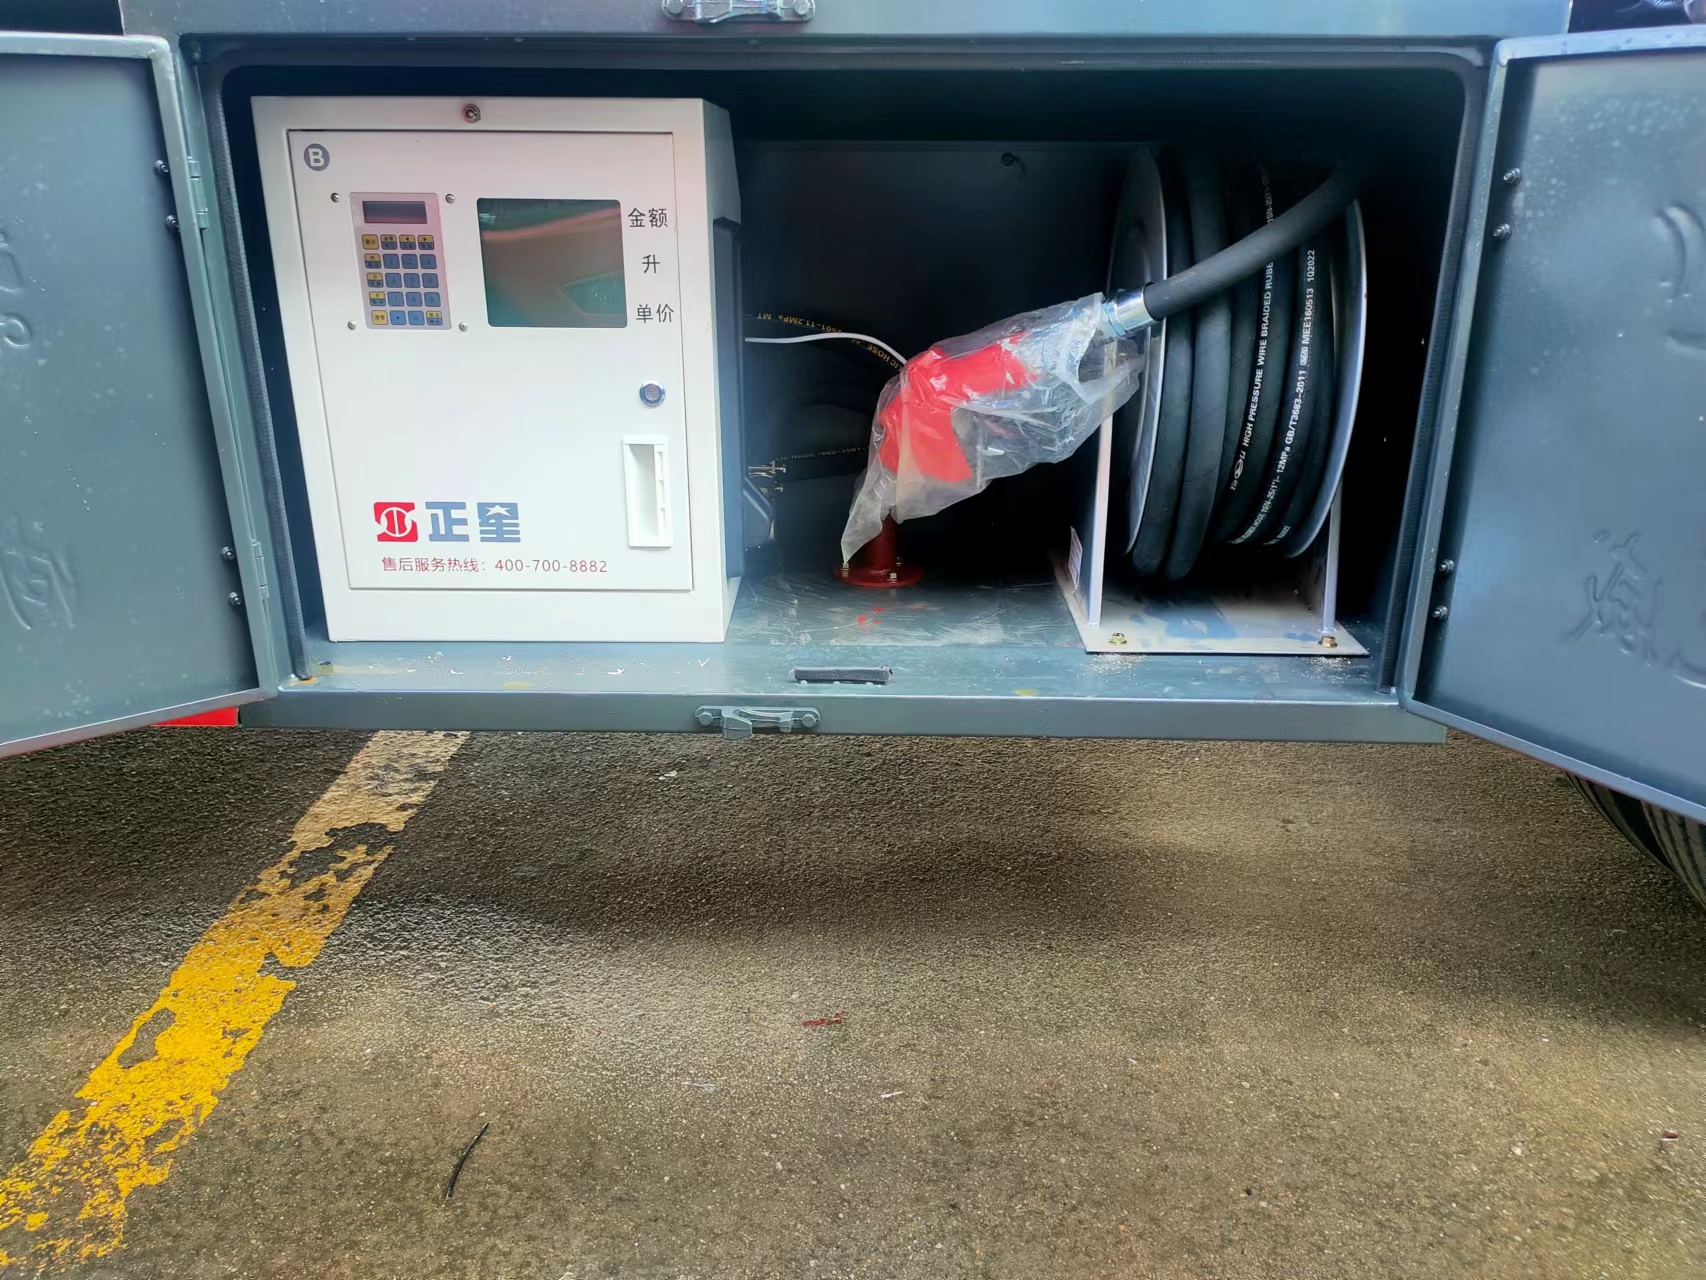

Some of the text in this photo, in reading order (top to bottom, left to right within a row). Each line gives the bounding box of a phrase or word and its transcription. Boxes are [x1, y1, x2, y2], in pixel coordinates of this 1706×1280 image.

[308, 148, 325, 167] B
[627, 207, 668, 228] 金额
[641, 254, 661, 274] 升
[636, 303, 675, 323] 单价
[757, 312, 772, 321] MT
[1261, 291, 1272, 337] BRAIDED
[867, 344, 891, 362] HOSE
[1257, 339, 1268, 366] WIRE
[1276, 447, 1291, 473] 12MPa
[1285, 370, 1307, 445] GB/T3683-2011
[1301, 287, 1315, 345] MEE160513
[1248, 368, 1264, 421] PRESSURE
[1242, 422, 1254, 447] HIGH
[424, 501, 521, 543] 正星
[494, 559, 608, 573] 400-700-8882
